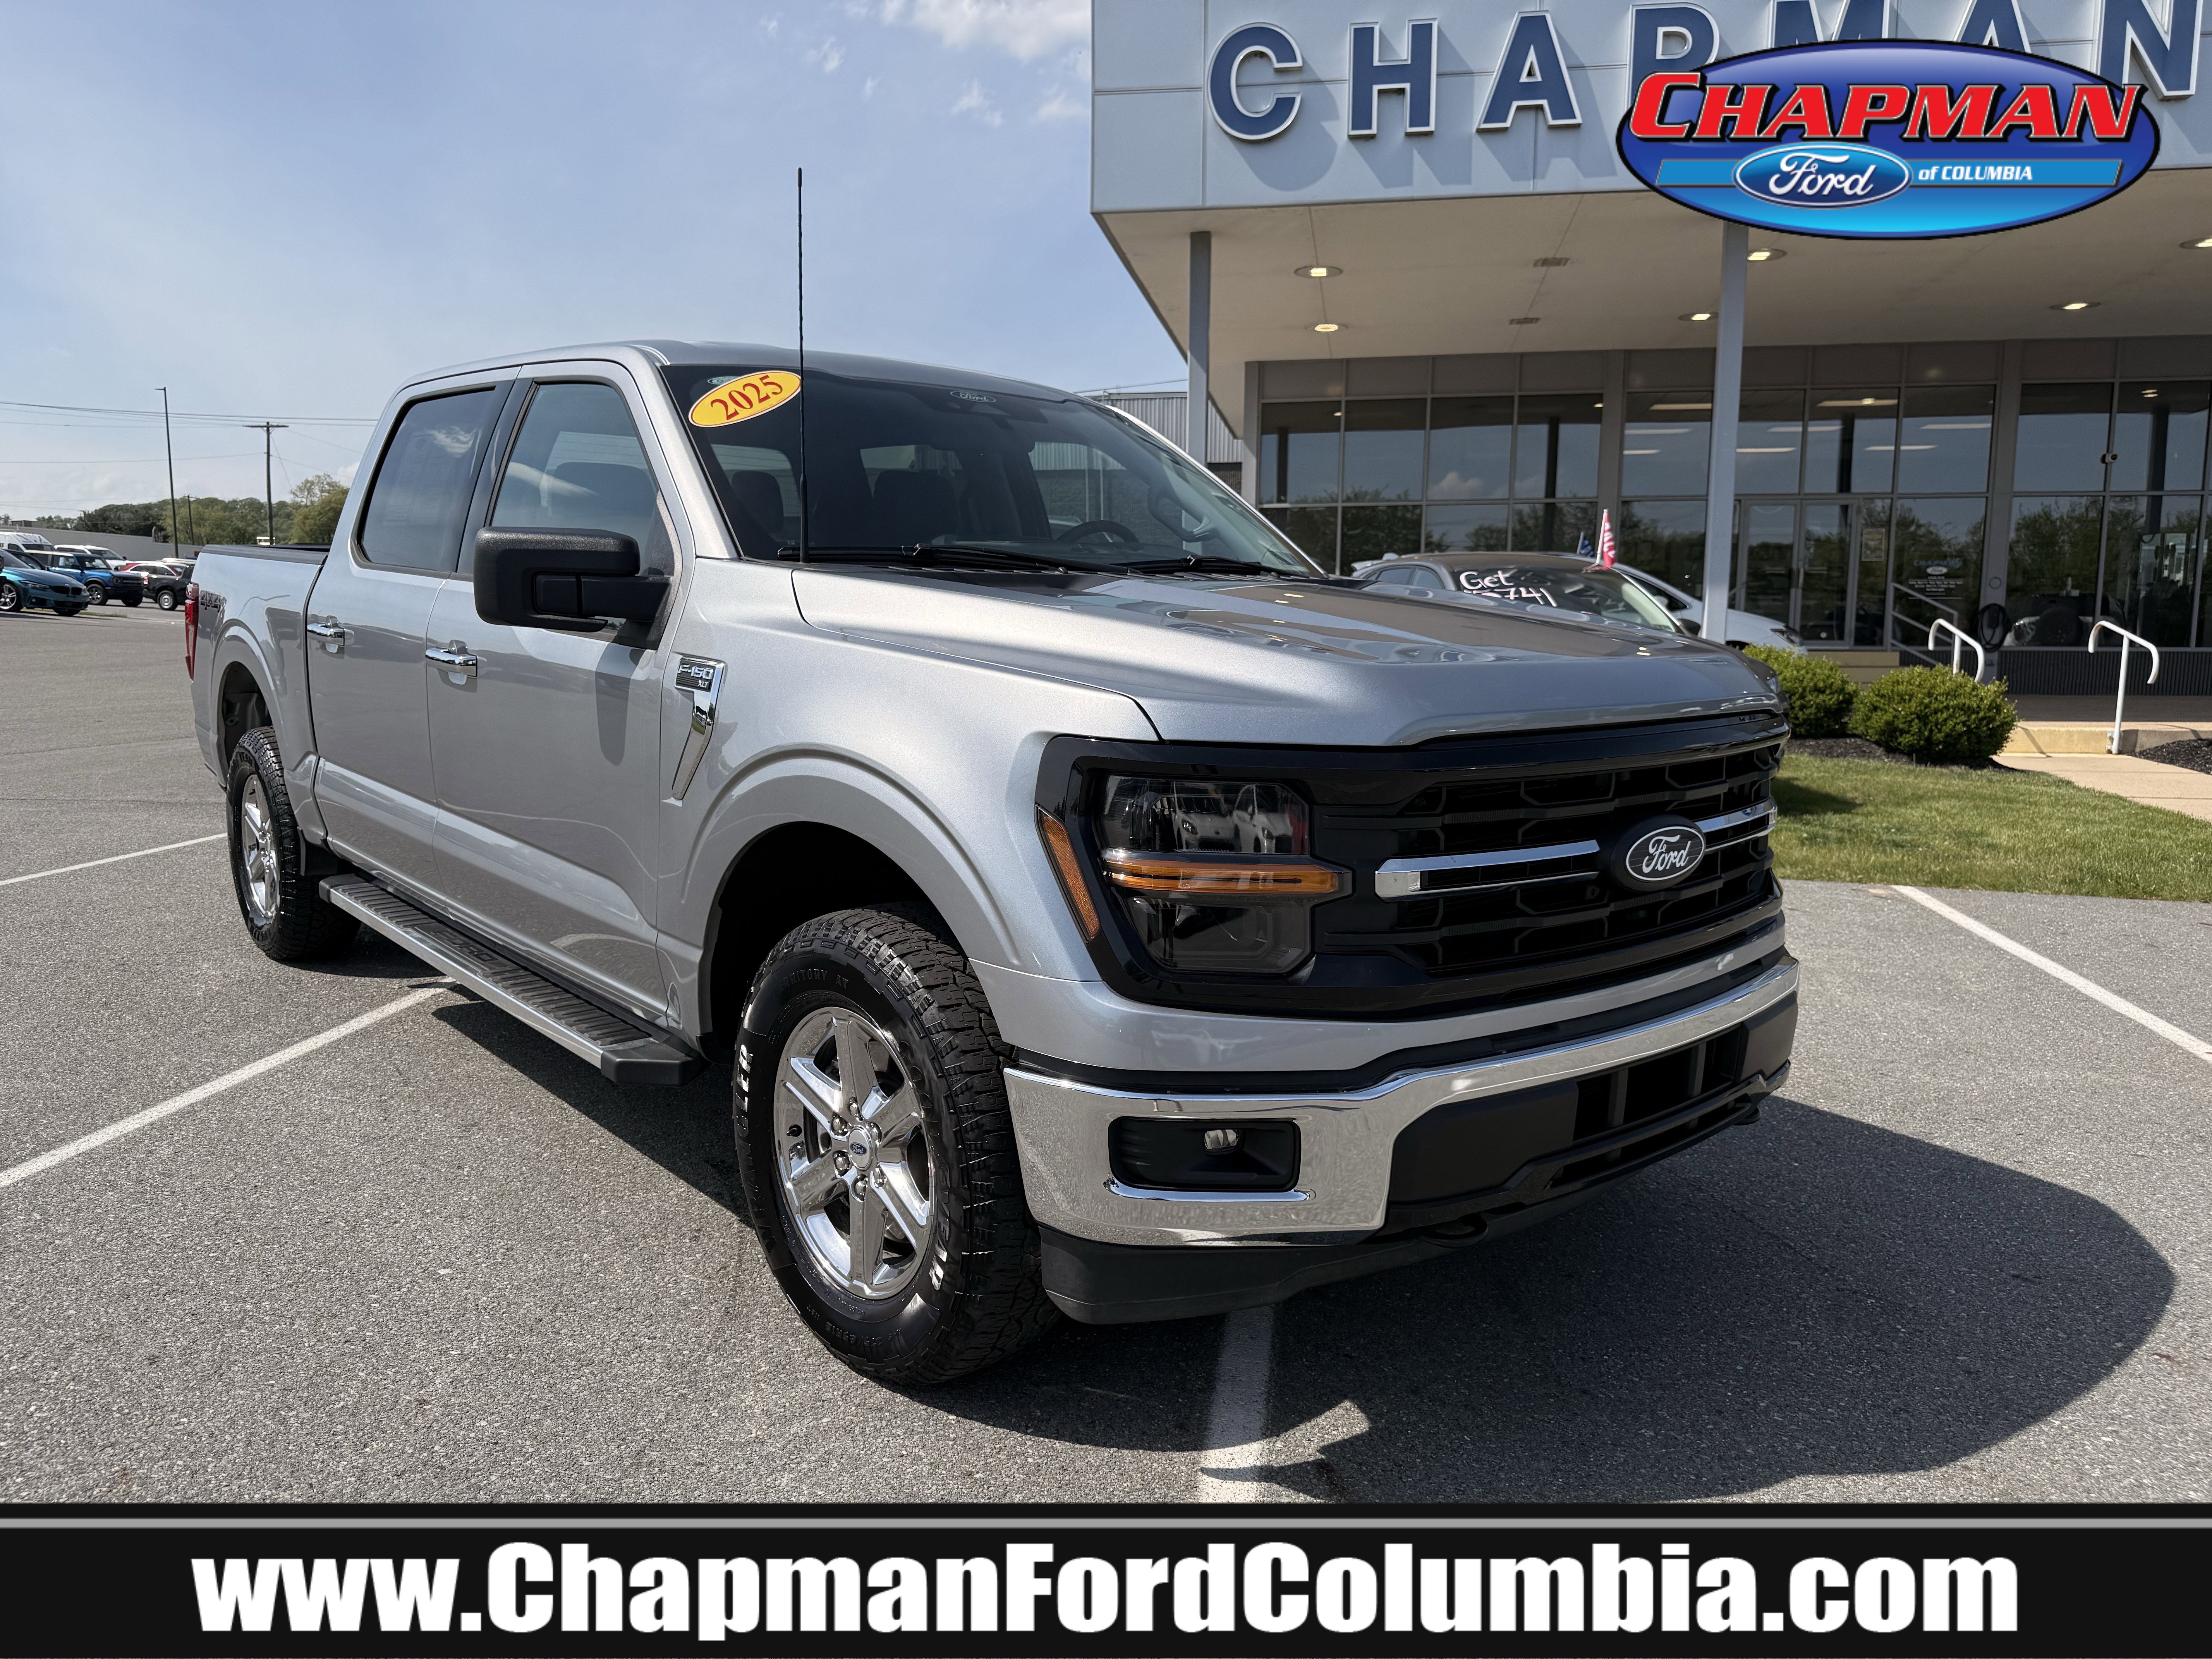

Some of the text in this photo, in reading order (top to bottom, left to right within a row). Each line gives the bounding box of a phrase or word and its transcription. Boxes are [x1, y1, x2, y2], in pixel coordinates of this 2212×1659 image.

[711, 375, 783, 420] 2025
[960, 392, 989, 402] Ford
[1460, 570, 1515, 589] Get
[1642, 835, 1692, 873] Ford
[835, 974, 849, 990] AT
[852, 1144, 864, 1154] Ford
